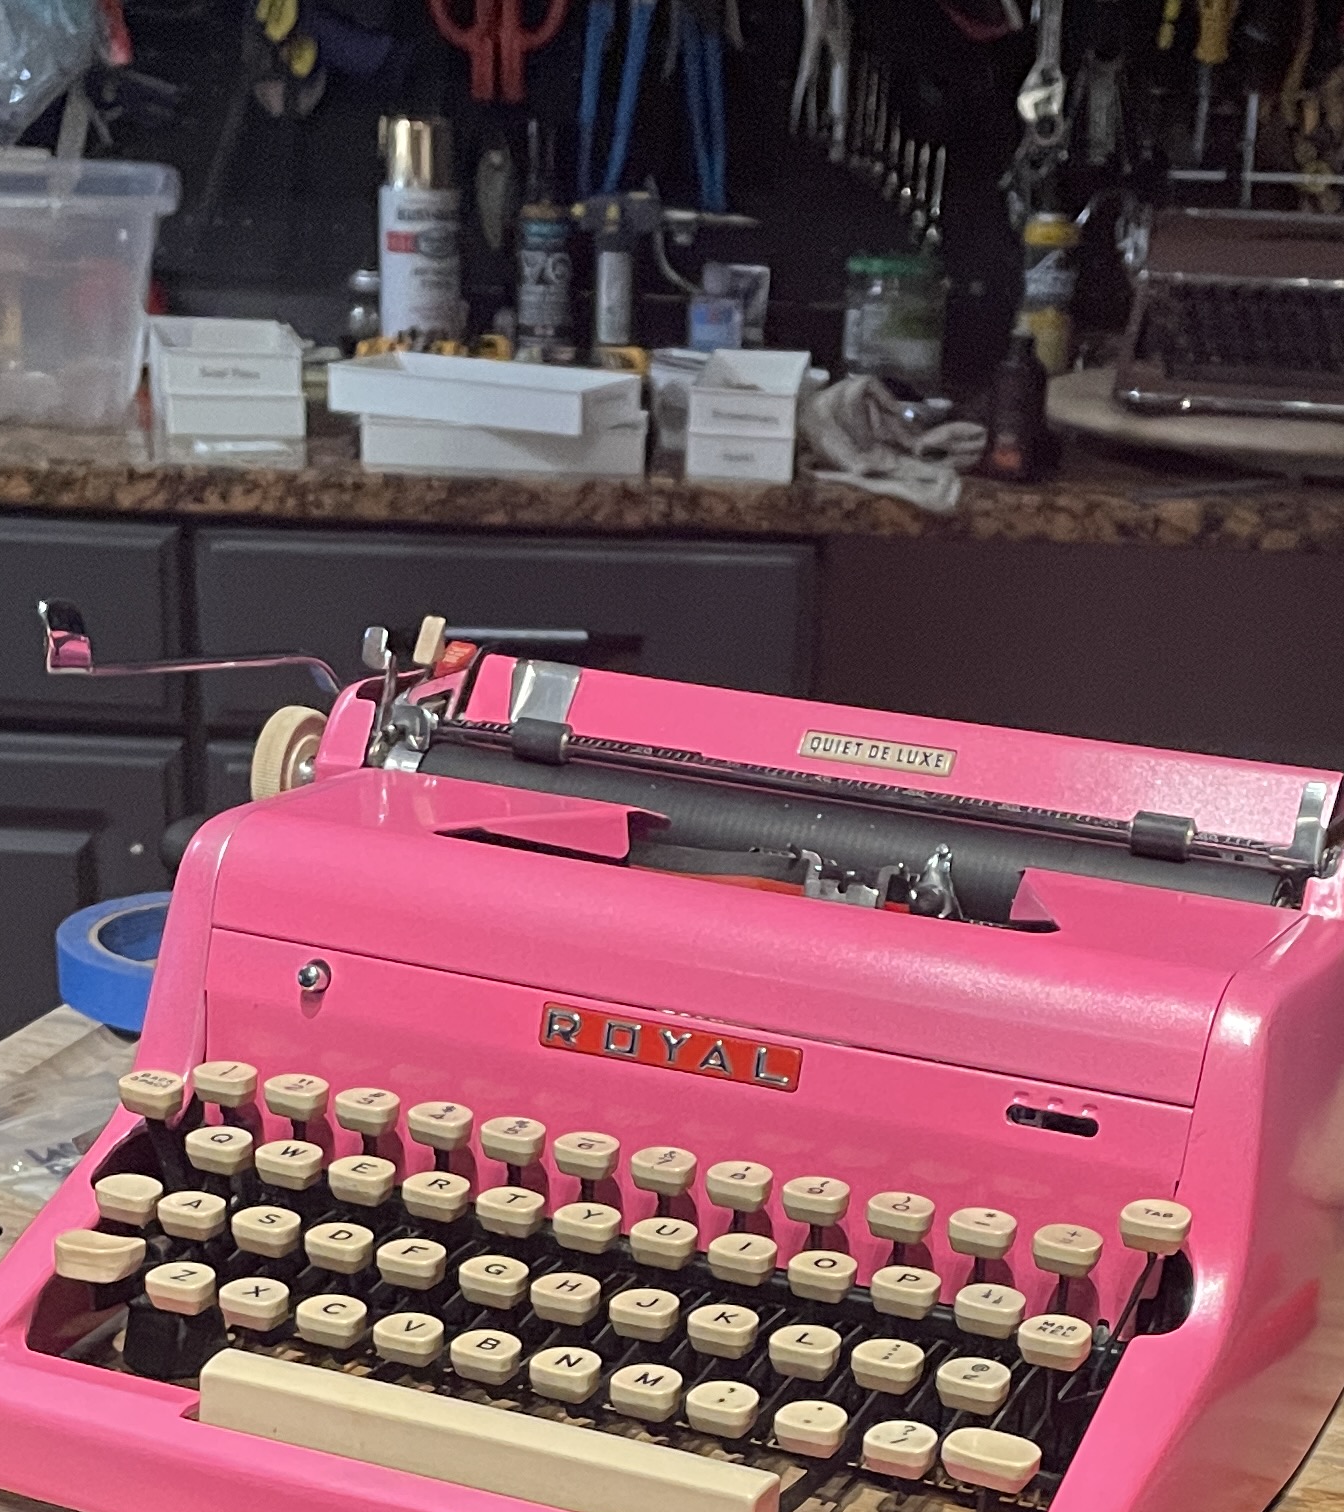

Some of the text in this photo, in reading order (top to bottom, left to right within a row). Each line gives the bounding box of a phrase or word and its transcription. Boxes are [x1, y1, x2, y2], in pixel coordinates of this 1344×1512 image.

[809, 736, 945, 768] QUIET DE LUXE
[545, 1007, 790, 1087] ROYAL
[210, 1133, 234, 1144] Q
[280, 1145, 309, 1158] W
[351, 1162, 379, 1174] E
[427, 1178, 452, 1190] R
[181, 1199, 203, 1210] A
[506, 1193, 529, 1204] T
[257, 1213, 281, 1225] S
[582, 1208, 605, 1220] Y
[1143, 1207, 1175, 1219] TAB
[328, 1229, 353, 1241] D
[655, 1224, 681, 1236] U
[400, 1245, 429, 1256] F
[484, 1263, 508, 1275] G
[813, 1258, 838, 1269] O
[170, 1269, 198, 1282] Z
[896, 1273, 922, 1284] P
[242, 1285, 271, 1298] X
[555, 1280, 583, 1292] H
[322, 1302, 347, 1315] C
[636, 1297, 660, 1308] J
[713, 1312, 739, 1324] K
[403, 1320, 427, 1333] V
[475, 1337, 500, 1350] B
[795, 1331, 814, 1346] L
[554, 1353, 583, 1368] N
[633, 1371, 665, 1387] M
